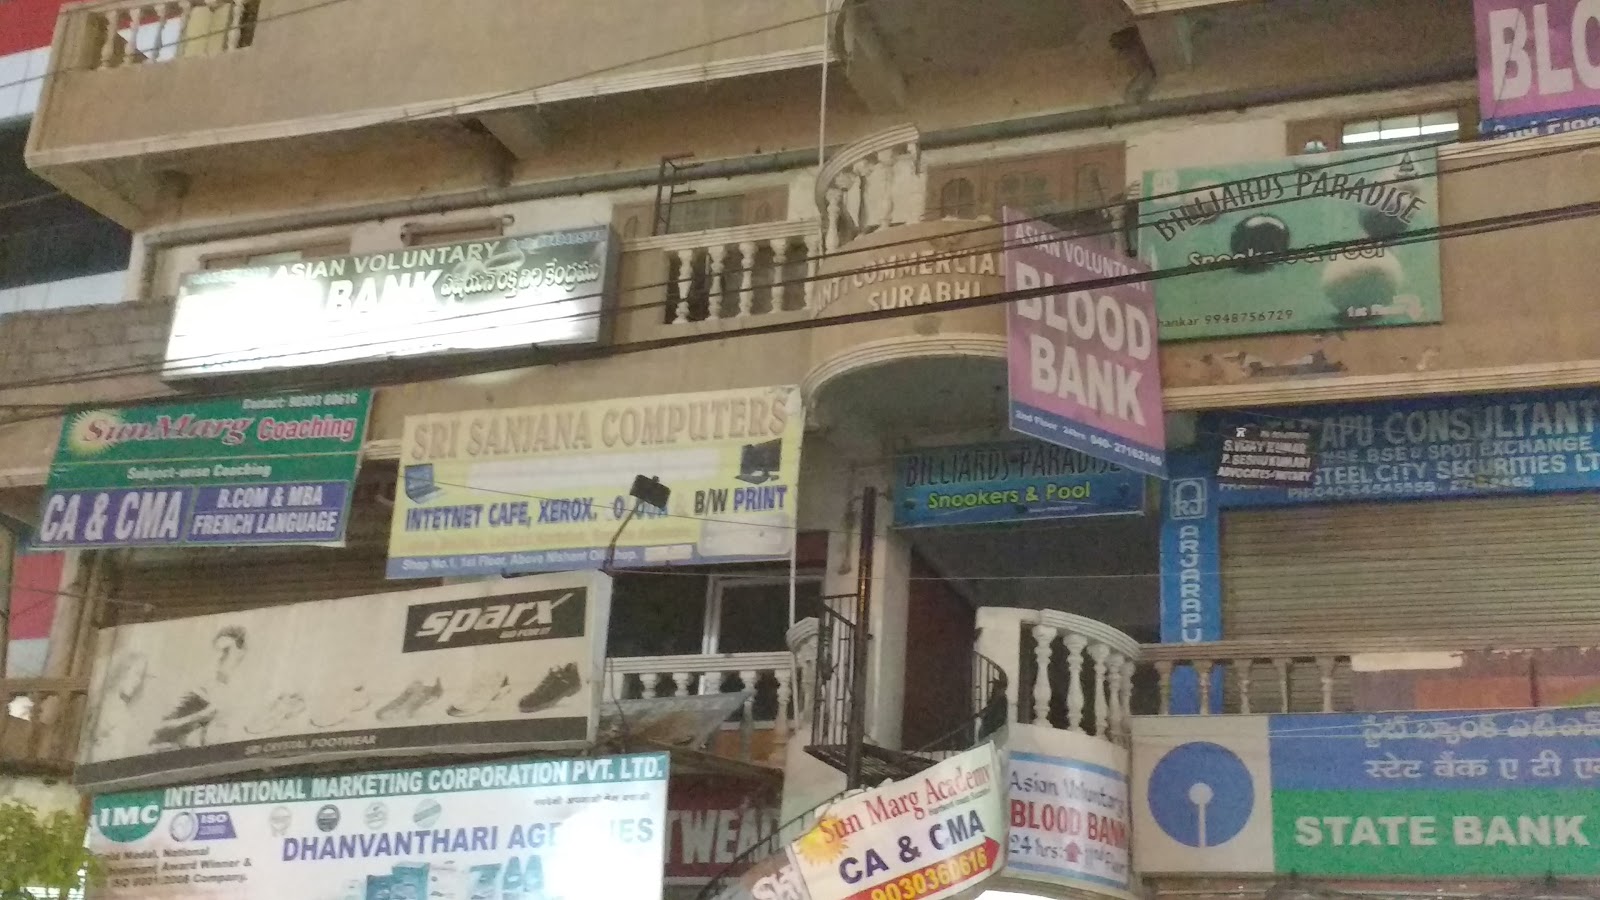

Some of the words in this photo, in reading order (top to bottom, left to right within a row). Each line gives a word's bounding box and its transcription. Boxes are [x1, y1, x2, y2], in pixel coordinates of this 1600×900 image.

[1154, 178, 1284, 242] BILLIARDS
[1296, 171, 1427, 224] PARADISE
[273, 259, 346, 281] ASIAN
[354, 242, 500, 274] VOLUNTARY
[325, 269, 445, 318] BANK
[868, 281, 983, 312] SURABHI
[1016, 261, 1152, 361] BLOOD
[1030, 333, 1147, 427] BANK
[257, 414, 358, 442] Coaching
[601, 396, 786, 447] COMPUTERS
[270, 486, 284, 506] &
[488, 501, 531, 529] CAFE,
[694, 488, 728, 515] B/W
[733, 484, 787, 511] PRINT
[928, 490, 1019, 509] Snookers
[1026, 486, 1039, 502] &
[1046, 481, 1090, 500] Pool
[40, 494, 80, 541] CA
[85, 494, 110, 540] &
[114, 491, 182, 540] CMA
[191, 512, 252, 536] FRENCH
[256, 511, 339, 534] LANGUAGE
[416, 593, 574, 642] sparx
[164, 776, 306, 807] INTERNATIONAL
[311, 770, 424, 798] MARKETING
[430, 761, 567, 792] CORPORATION
[572, 758, 615, 782] PVT.
[619, 756, 664, 780] LTD.
[1009, 770, 1059, 797] Asian
[99, 804, 160, 828] IMC
[201, 814, 228, 824] ISO
[820, 812, 863, 844] Sun
[864, 791, 926, 821] Marg
[1010, 799, 1081, 836] BLOOD
[1295, 815, 1437, 846] STATE
[1452, 815, 1591, 846] BANK
[283, 825, 498, 862] DHANVANTHARI
[838, 847, 890, 885] CA
[898, 835, 922, 864] &
[928, 808, 986, 851] CMA
